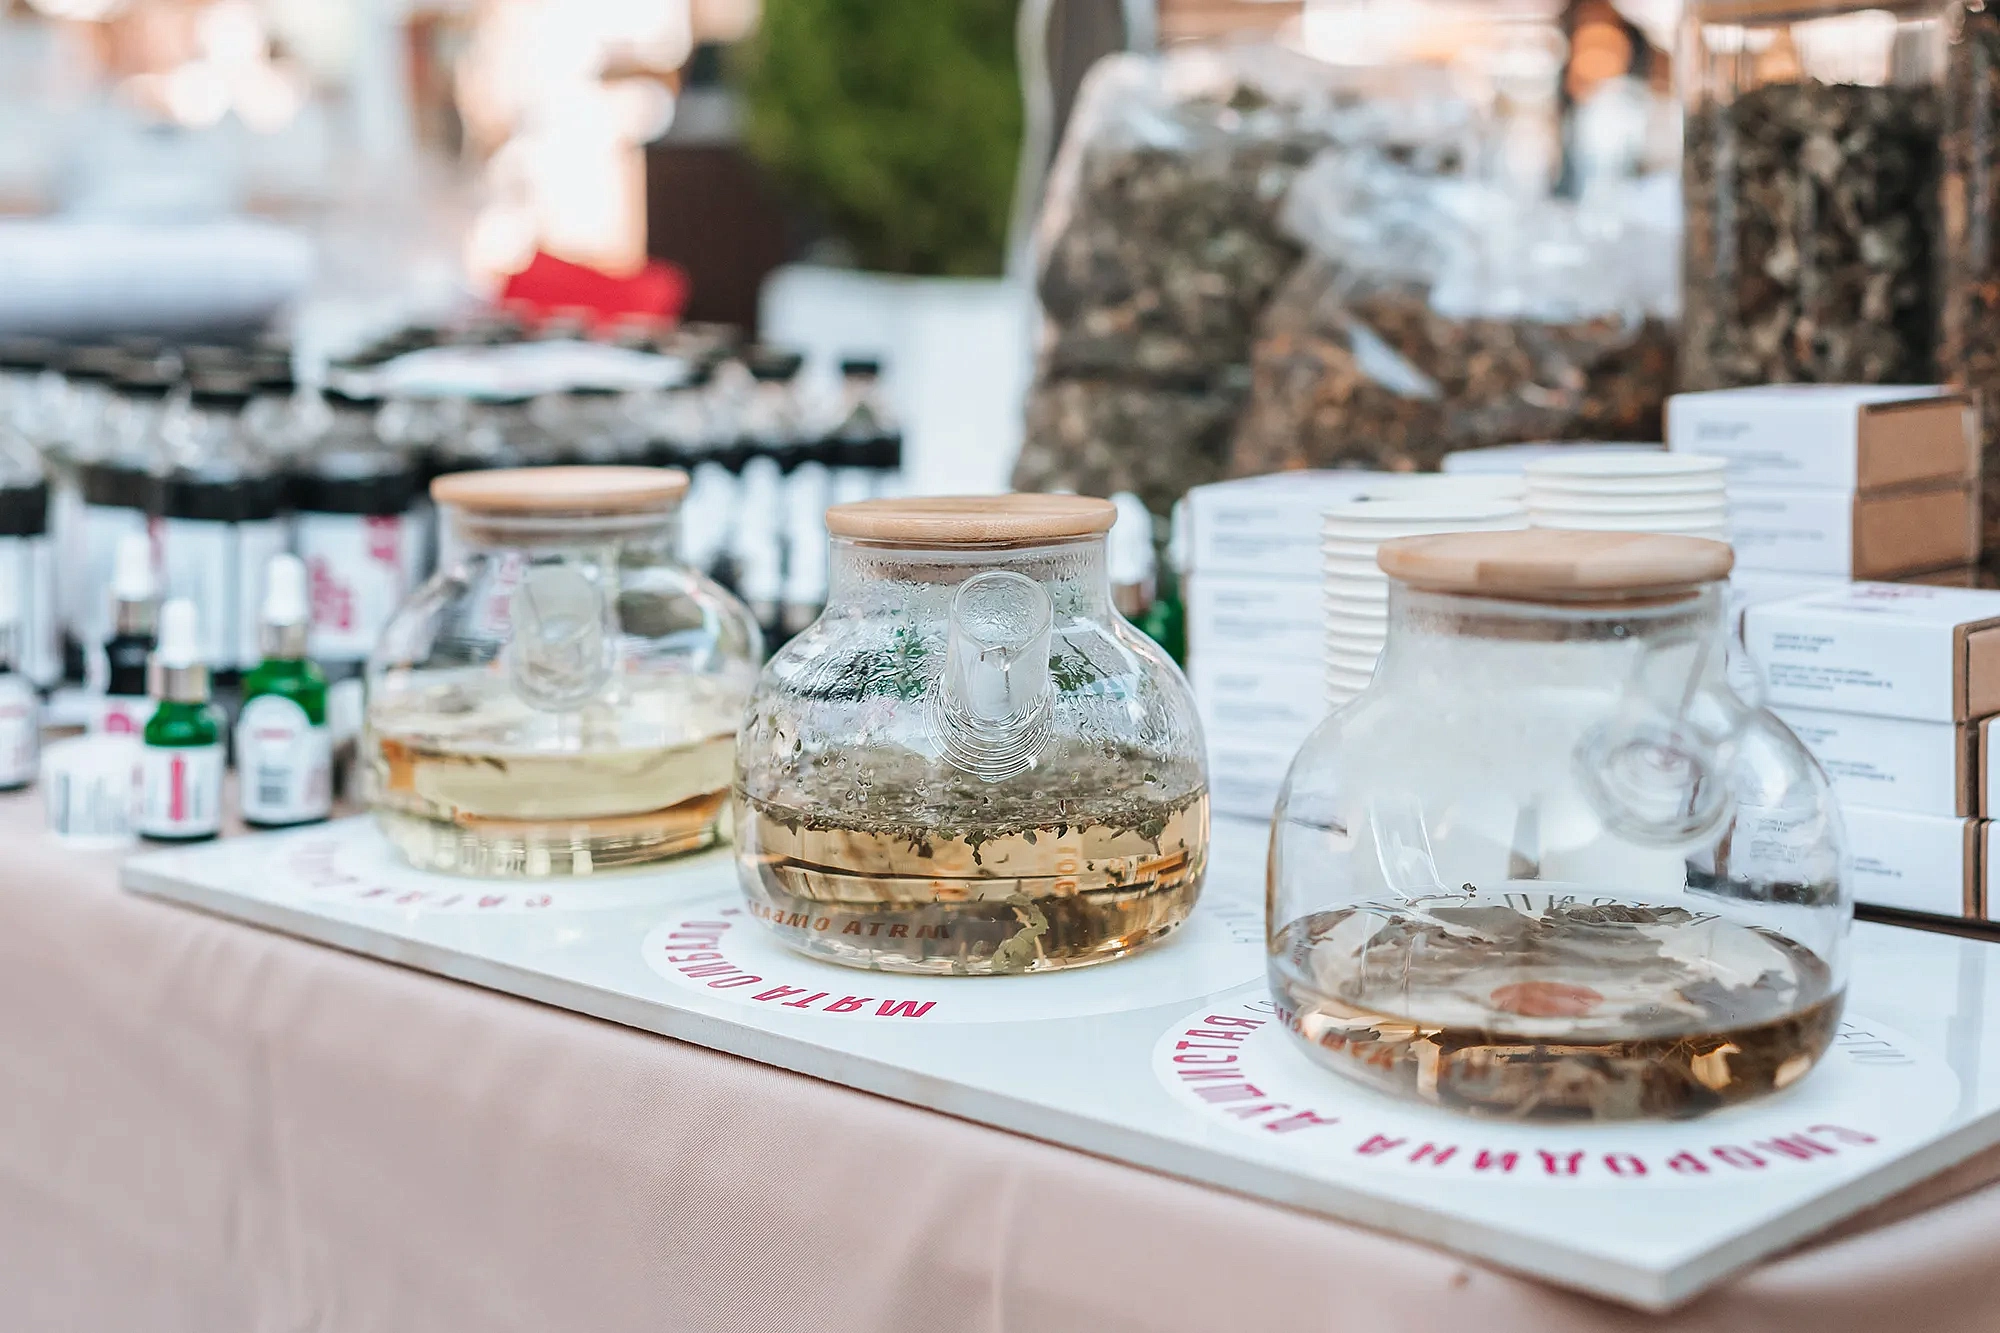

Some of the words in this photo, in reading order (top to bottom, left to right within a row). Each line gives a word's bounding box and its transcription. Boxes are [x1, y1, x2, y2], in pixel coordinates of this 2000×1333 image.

[751, 985, 937, 1019] МЯТА
[1172, 1014, 1338, 1133] ДУШИСТАЯ
[1355, 1123, 1879, 1177] СМОРОДИНА
